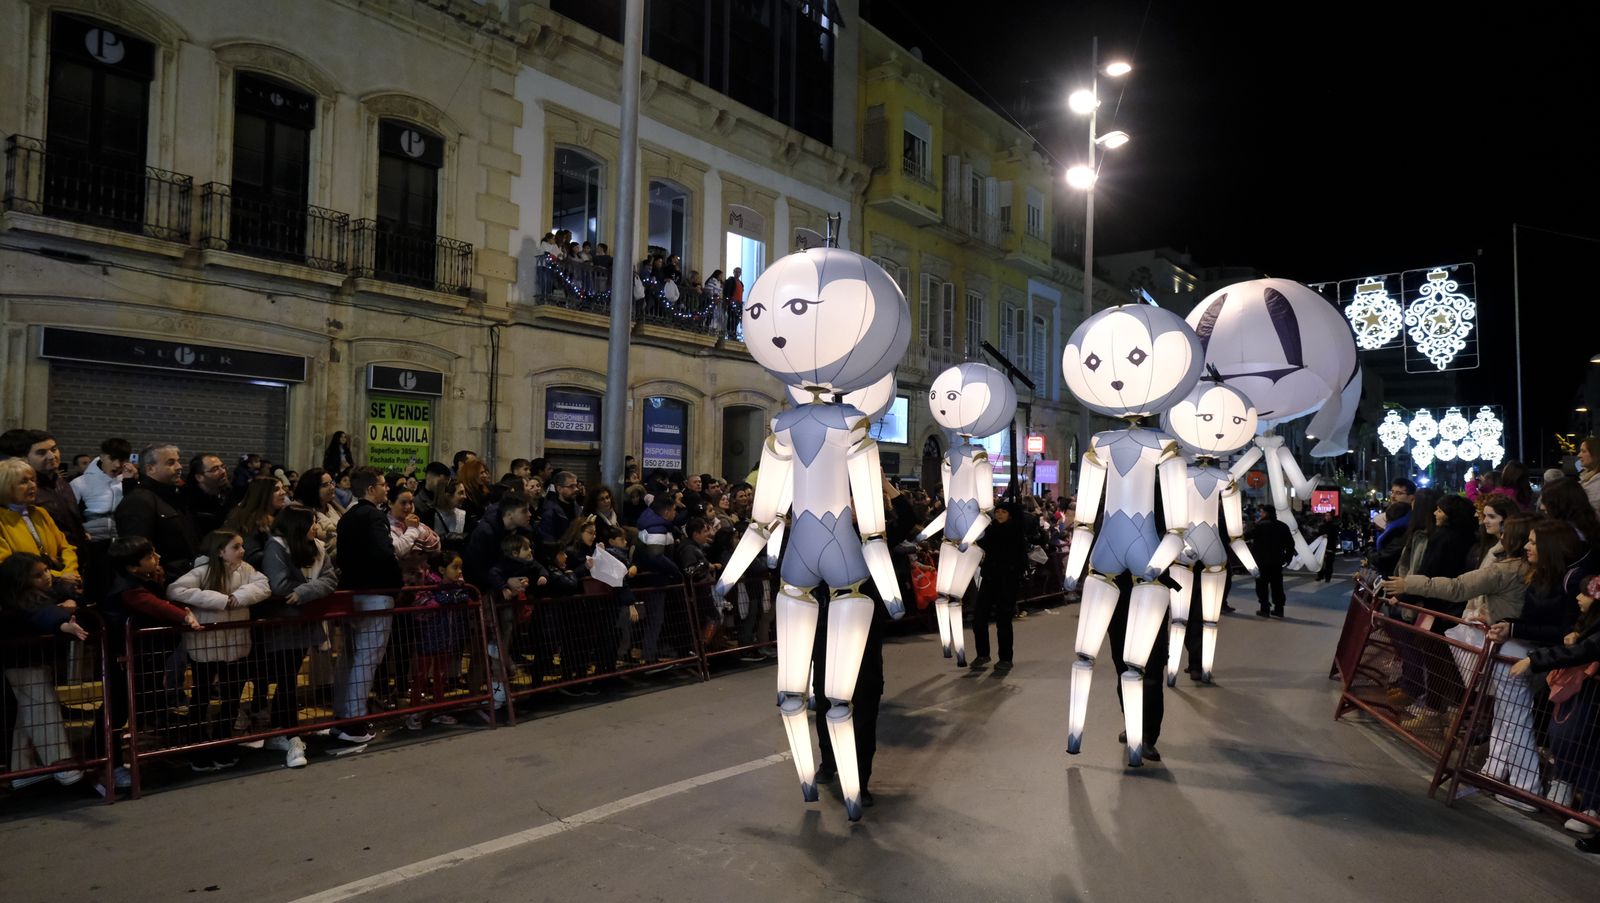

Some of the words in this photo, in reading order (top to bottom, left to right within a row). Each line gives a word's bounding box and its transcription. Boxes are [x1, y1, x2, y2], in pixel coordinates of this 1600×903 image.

[132, 345, 232, 366] SUPER
[370, 402, 386, 419] SE
[390, 404, 429, 422] VENDE
[553, 413, 589, 422] DISPONIBLE
[550, 421, 564, 429] 950
[575, 422, 584, 430] 25
[370, 425, 377, 441] O
[381, 425, 428, 443] ALQUILA
[645, 447, 681, 456] DISPONIBLE
[645, 459, 657, 467] 950
